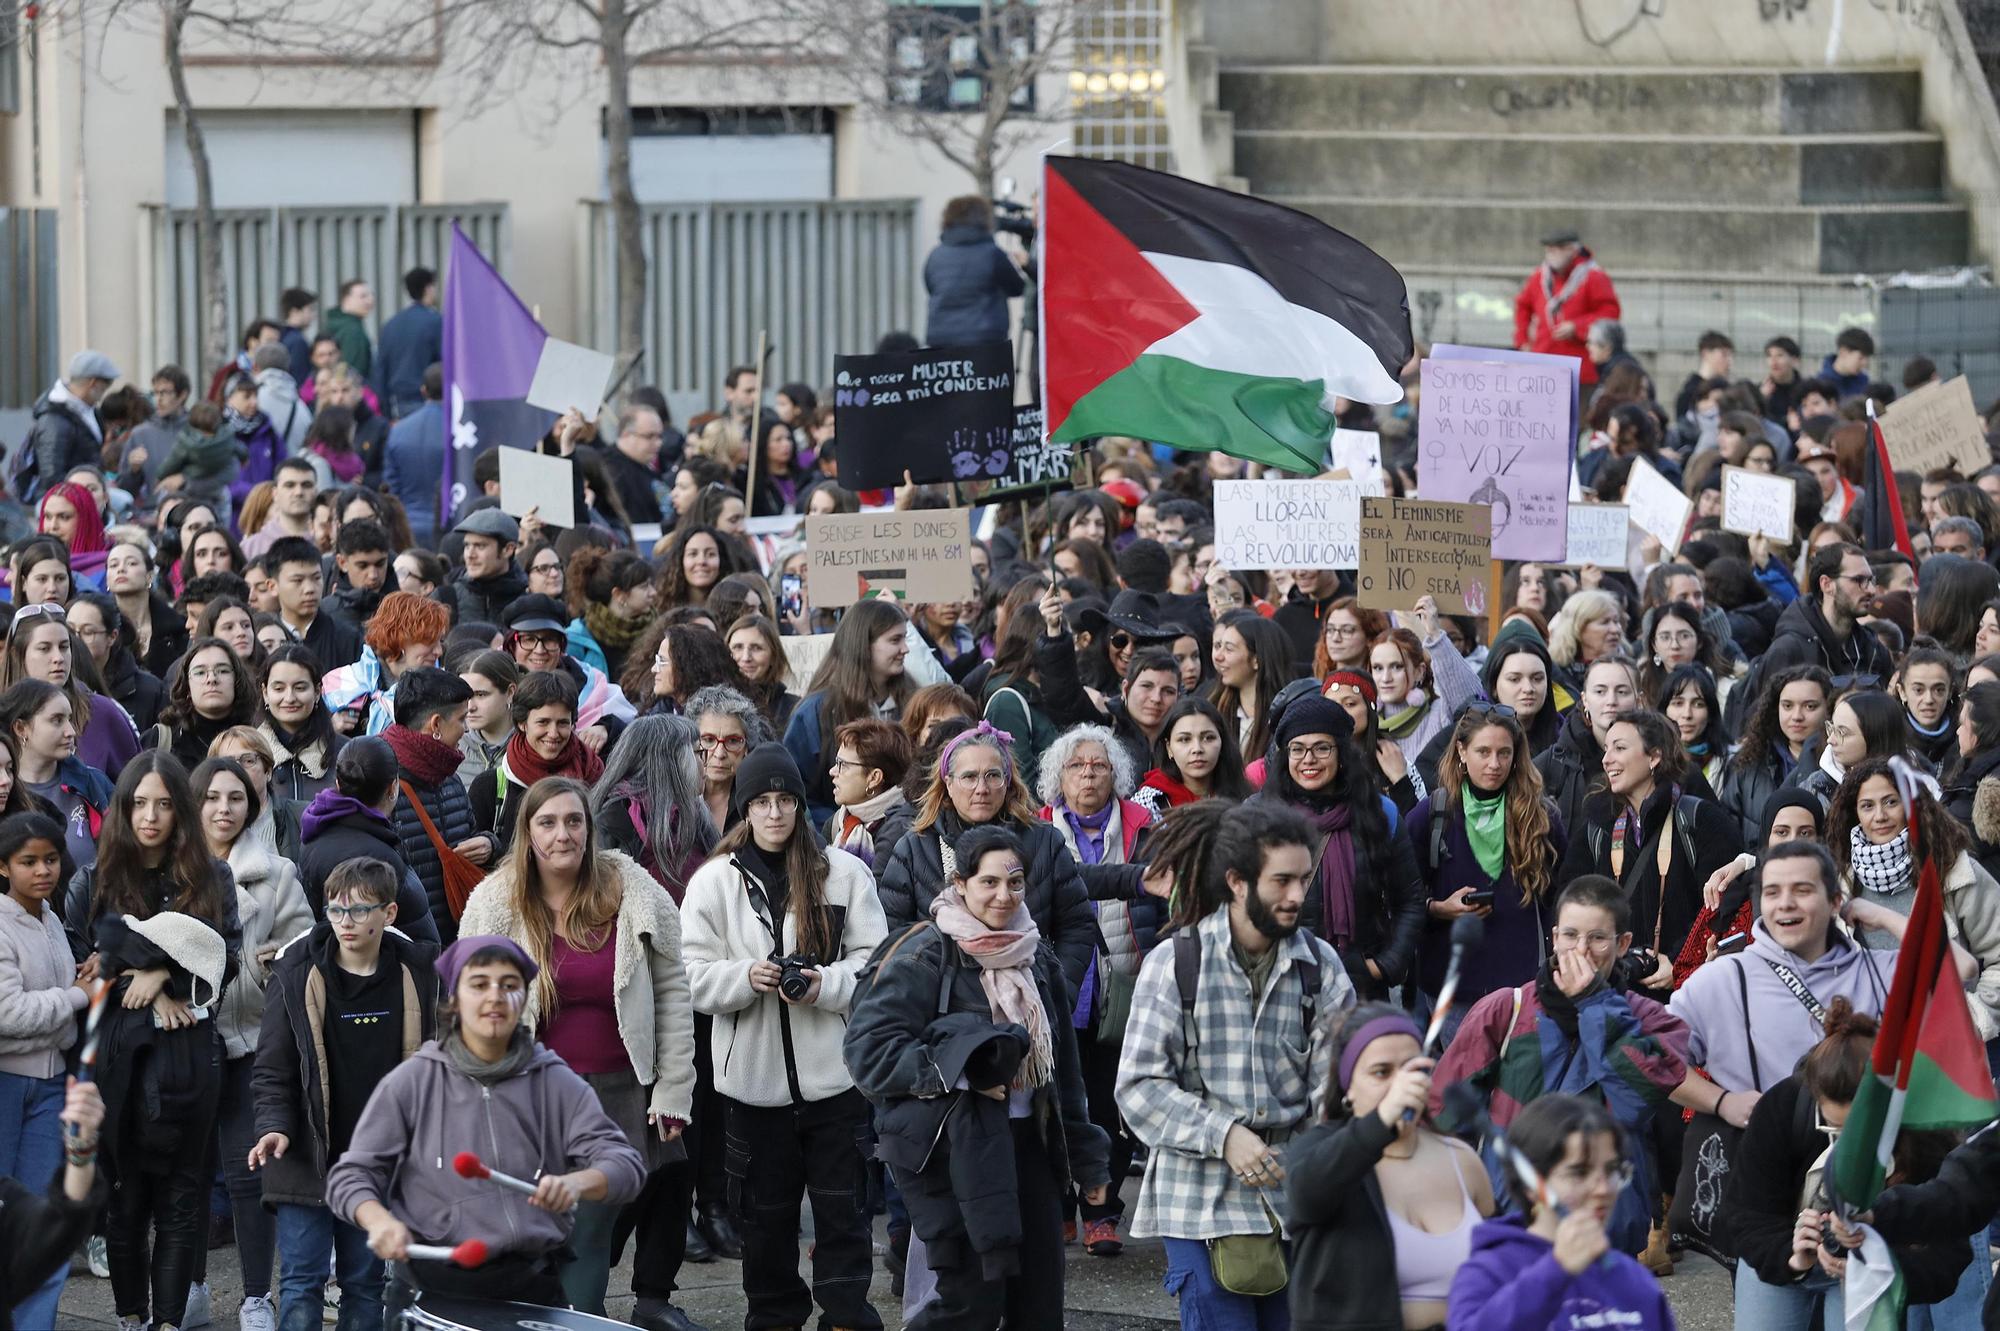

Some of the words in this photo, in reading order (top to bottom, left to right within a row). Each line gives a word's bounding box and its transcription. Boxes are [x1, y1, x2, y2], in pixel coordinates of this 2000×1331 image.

[837, 370, 862, 387] Que
[912, 360, 975, 380] MUJER
[1432, 367, 1486, 391] SOMOS
[1495, 375, 1512, 392] EL
[1517, 376, 1556, 396] GRITO
[836, 389, 870, 407] NO
[872, 392, 902, 406] sea
[907, 381, 930, 401] mi
[933, 373, 1010, 396] CONDENA
[1439, 396, 1454, 413] DE
[1462, 398, 1491, 416] LAS
[1497, 399, 1526, 418] QUE
[1435, 417, 1455, 434] YA
[1464, 419, 1489, 437] NO
[1496, 419, 1556, 441] TIENEN
[1459, 443, 1525, 477] VOZ
[1219, 484, 1253, 502] LAS
[1266, 483, 1332, 502] MUJERES
[1337, 485, 1351, 502] YA
[1362, 498, 1383, 519] EL
[1392, 499, 1464, 523] FEMINISME
[818, 524, 864, 543] SENSE
[873, 522, 902, 538] LES
[913, 522, 957, 539] DONES
[1221, 525, 1258, 544] LAS
[1276, 522, 1347, 542] MUJERES
[1362, 524, 1393, 540] SERÀ
[1405, 523, 1491, 547] ANTICAPITALISTA
[891, 547, 905, 563] NO
[908, 547, 918, 561] HI
[922, 547, 938, 561] HA
[944, 544, 962, 560] 8M
[1245, 543, 1358, 565] REVOLUCIONA
[1388, 567, 1415, 591] NO
[1426, 573, 1462, 595] SERÀ
